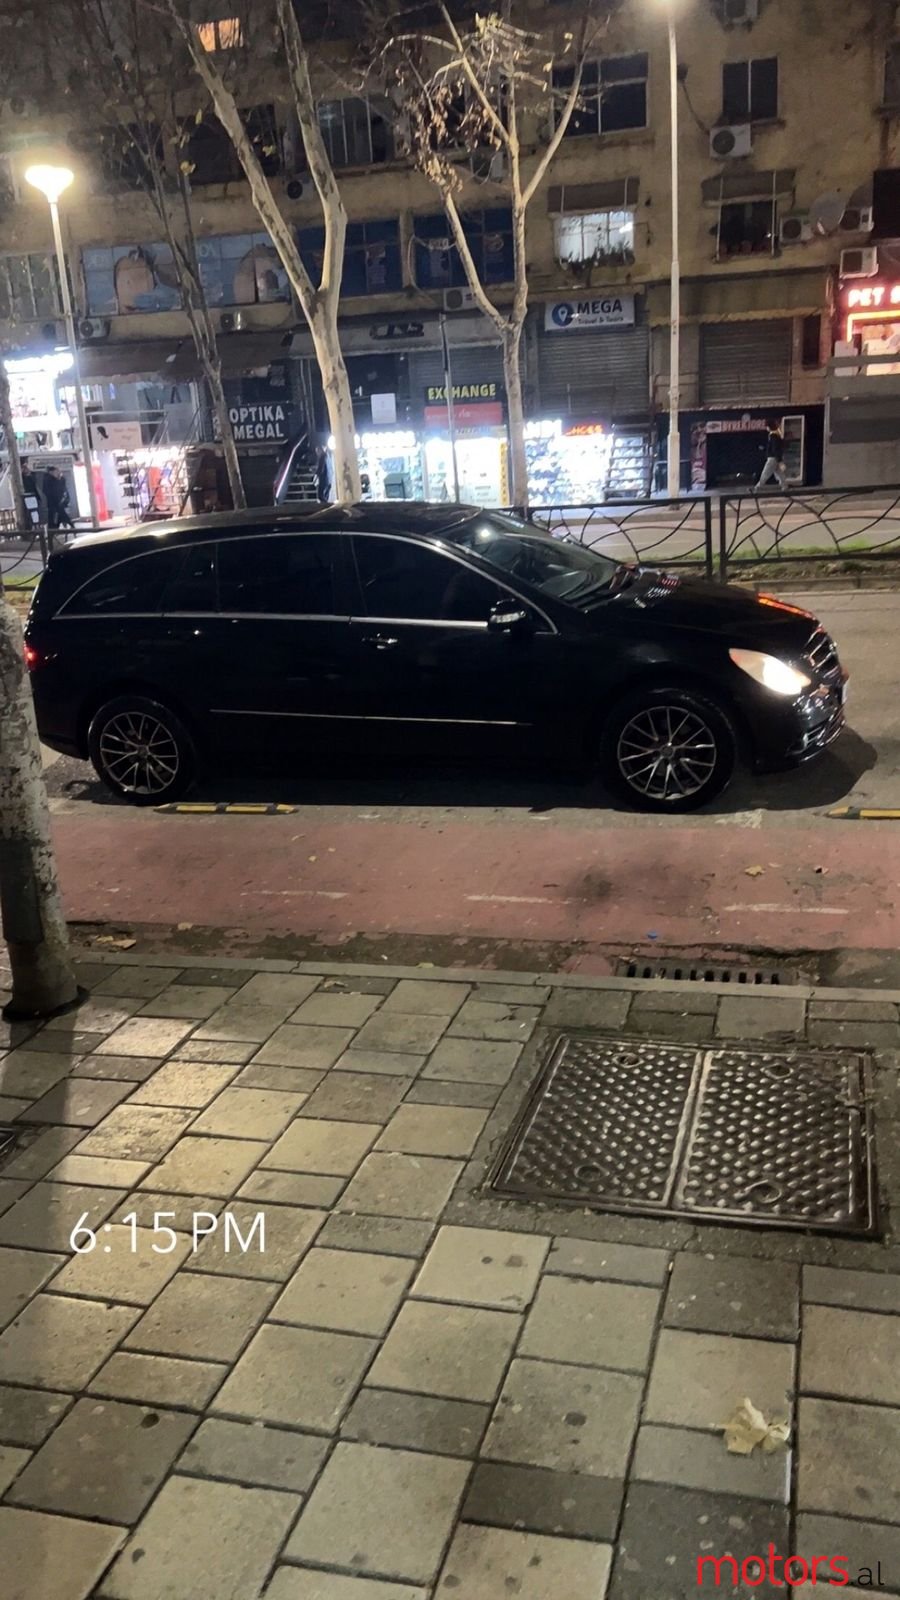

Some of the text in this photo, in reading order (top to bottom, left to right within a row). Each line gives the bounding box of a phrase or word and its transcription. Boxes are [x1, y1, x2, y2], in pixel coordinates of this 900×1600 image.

[848, 287, 885, 308] PET
[577, 299, 623, 314] MEGA
[229, 405, 285, 423] OPTIKA
[234, 423, 284, 440] MEGAL
